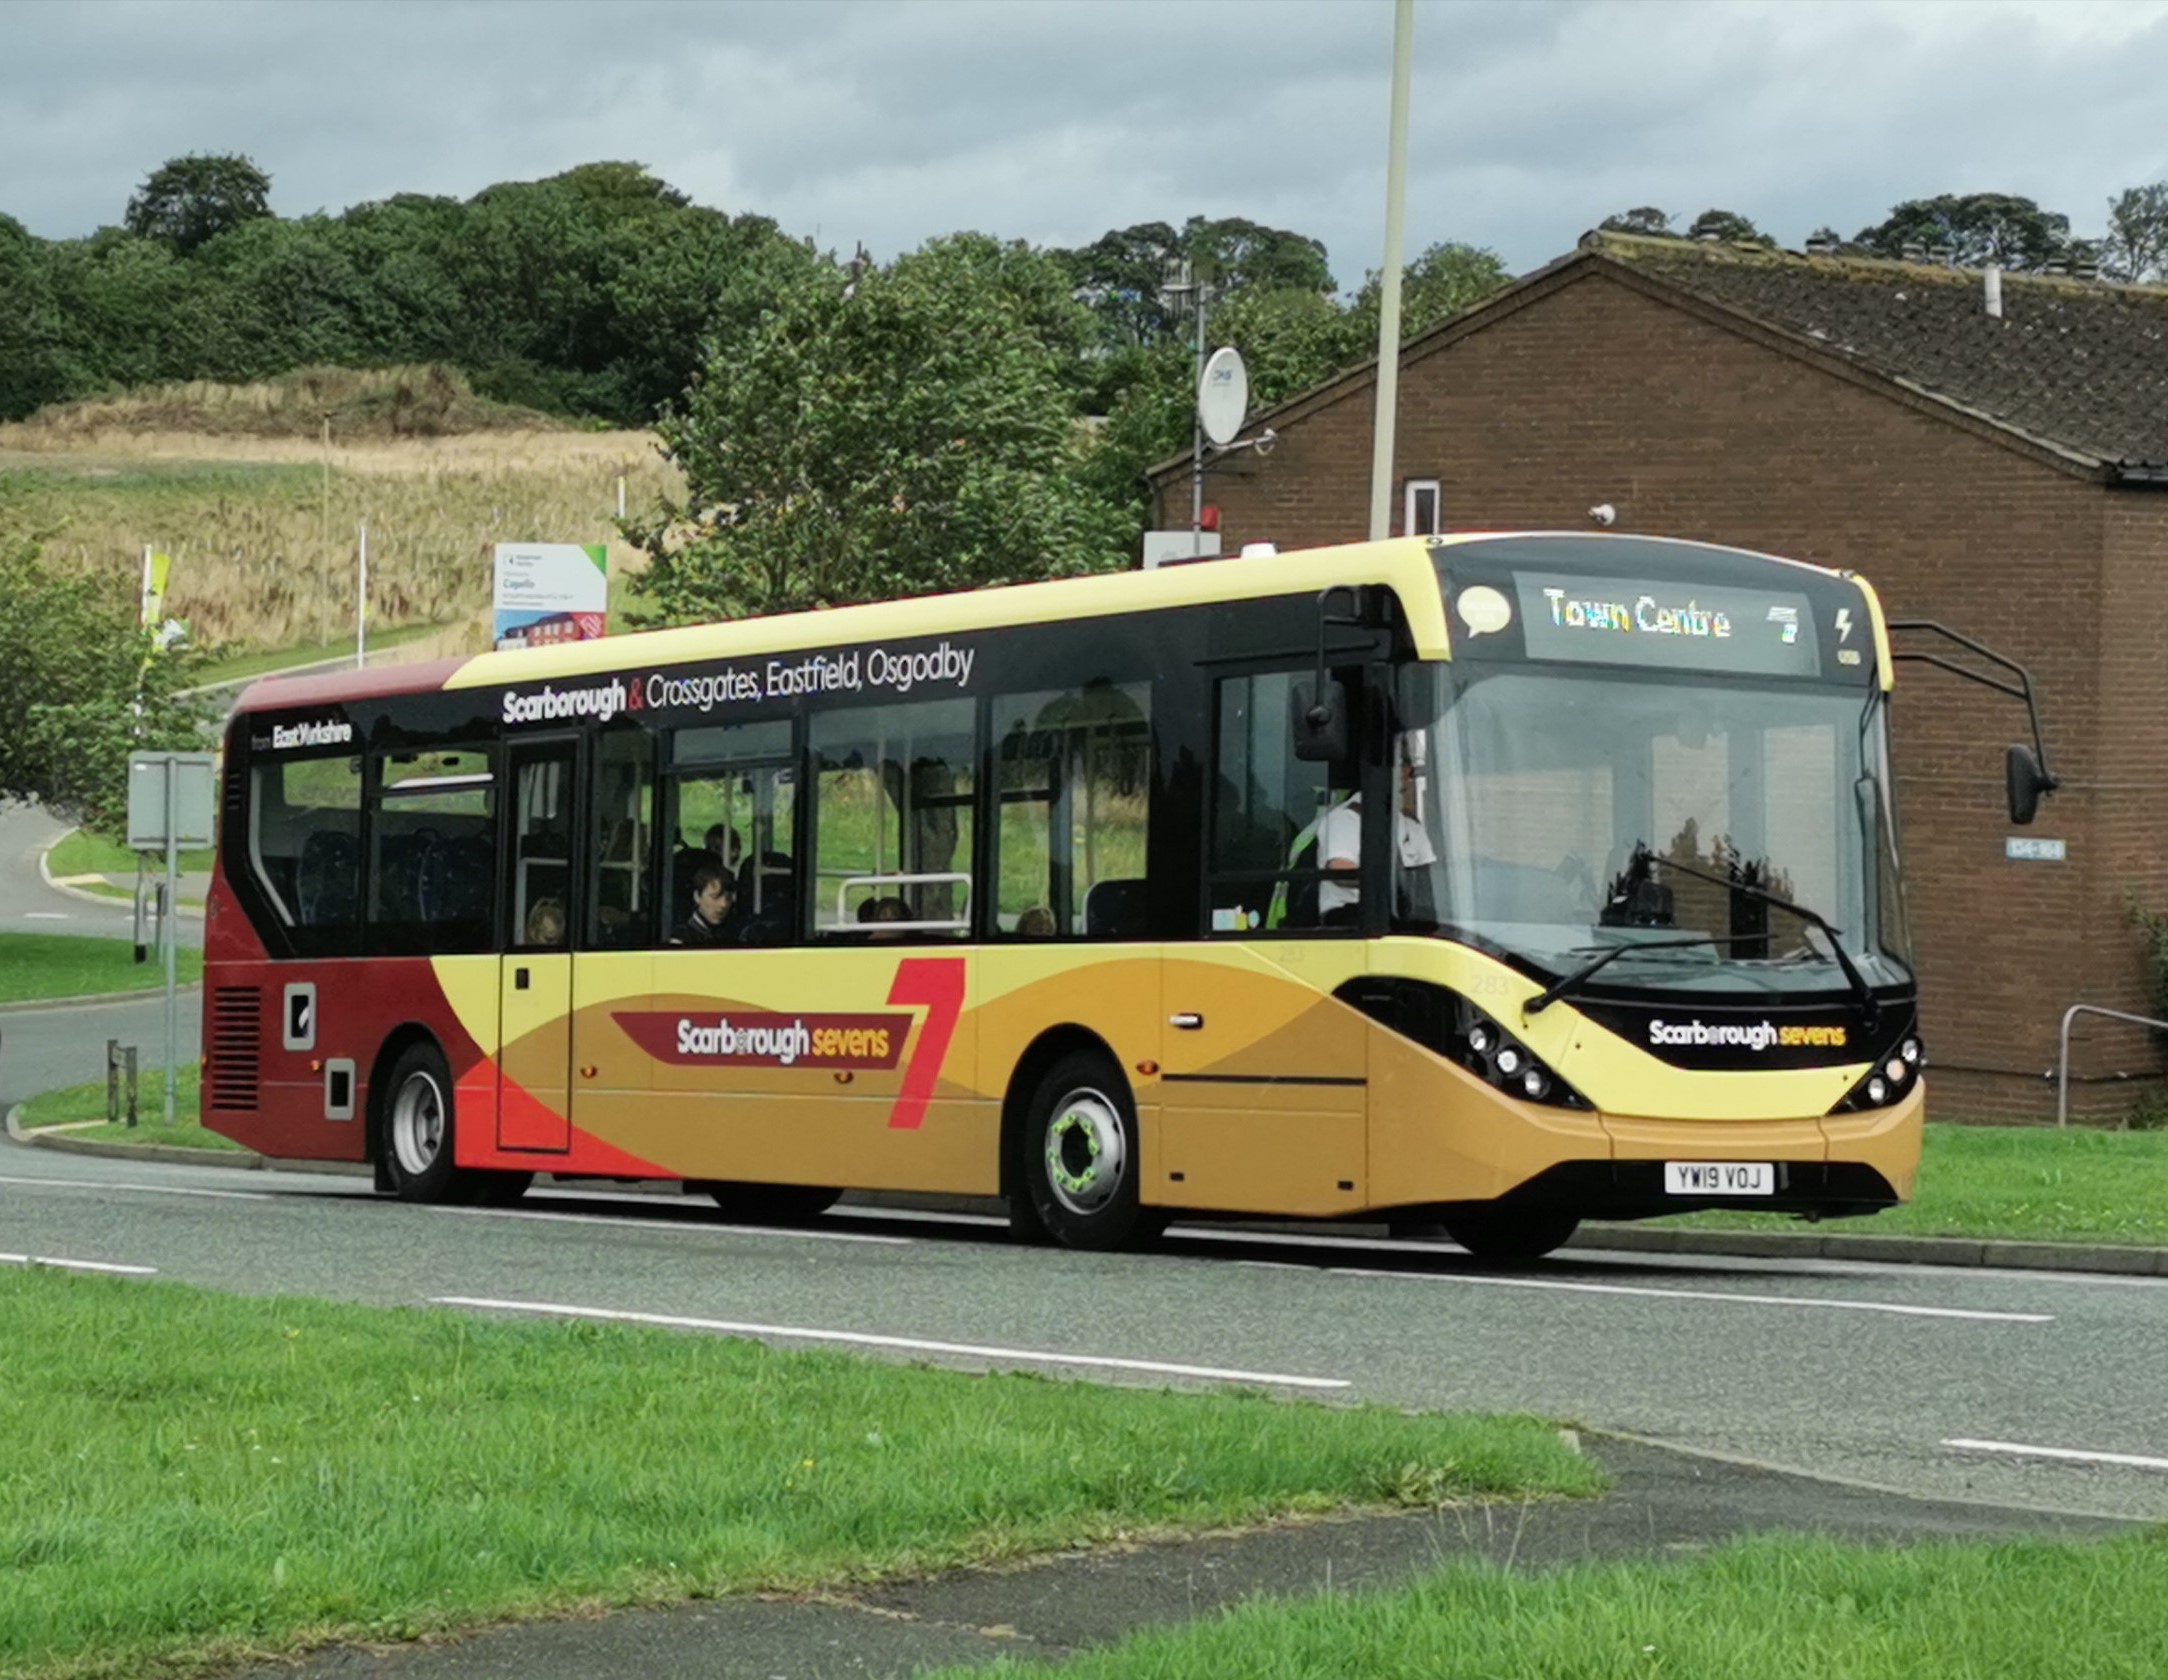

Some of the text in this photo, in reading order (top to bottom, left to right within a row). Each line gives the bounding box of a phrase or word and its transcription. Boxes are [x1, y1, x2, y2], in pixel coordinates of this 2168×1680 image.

[1543, 588, 1631, 632] Town
[1635, 595, 1731, 637] Centre
[502, 641, 975, 723] Scarborough & Crossgates, Eastfield, Osgodby
[677, 1018, 889, 1064] Scarborough sevens
[886, 957, 965, 1130] 7
[1650, 1019, 1846, 1050] Scarborough sevens
[1678, 1166, 1761, 1189] YW19 VOJ
